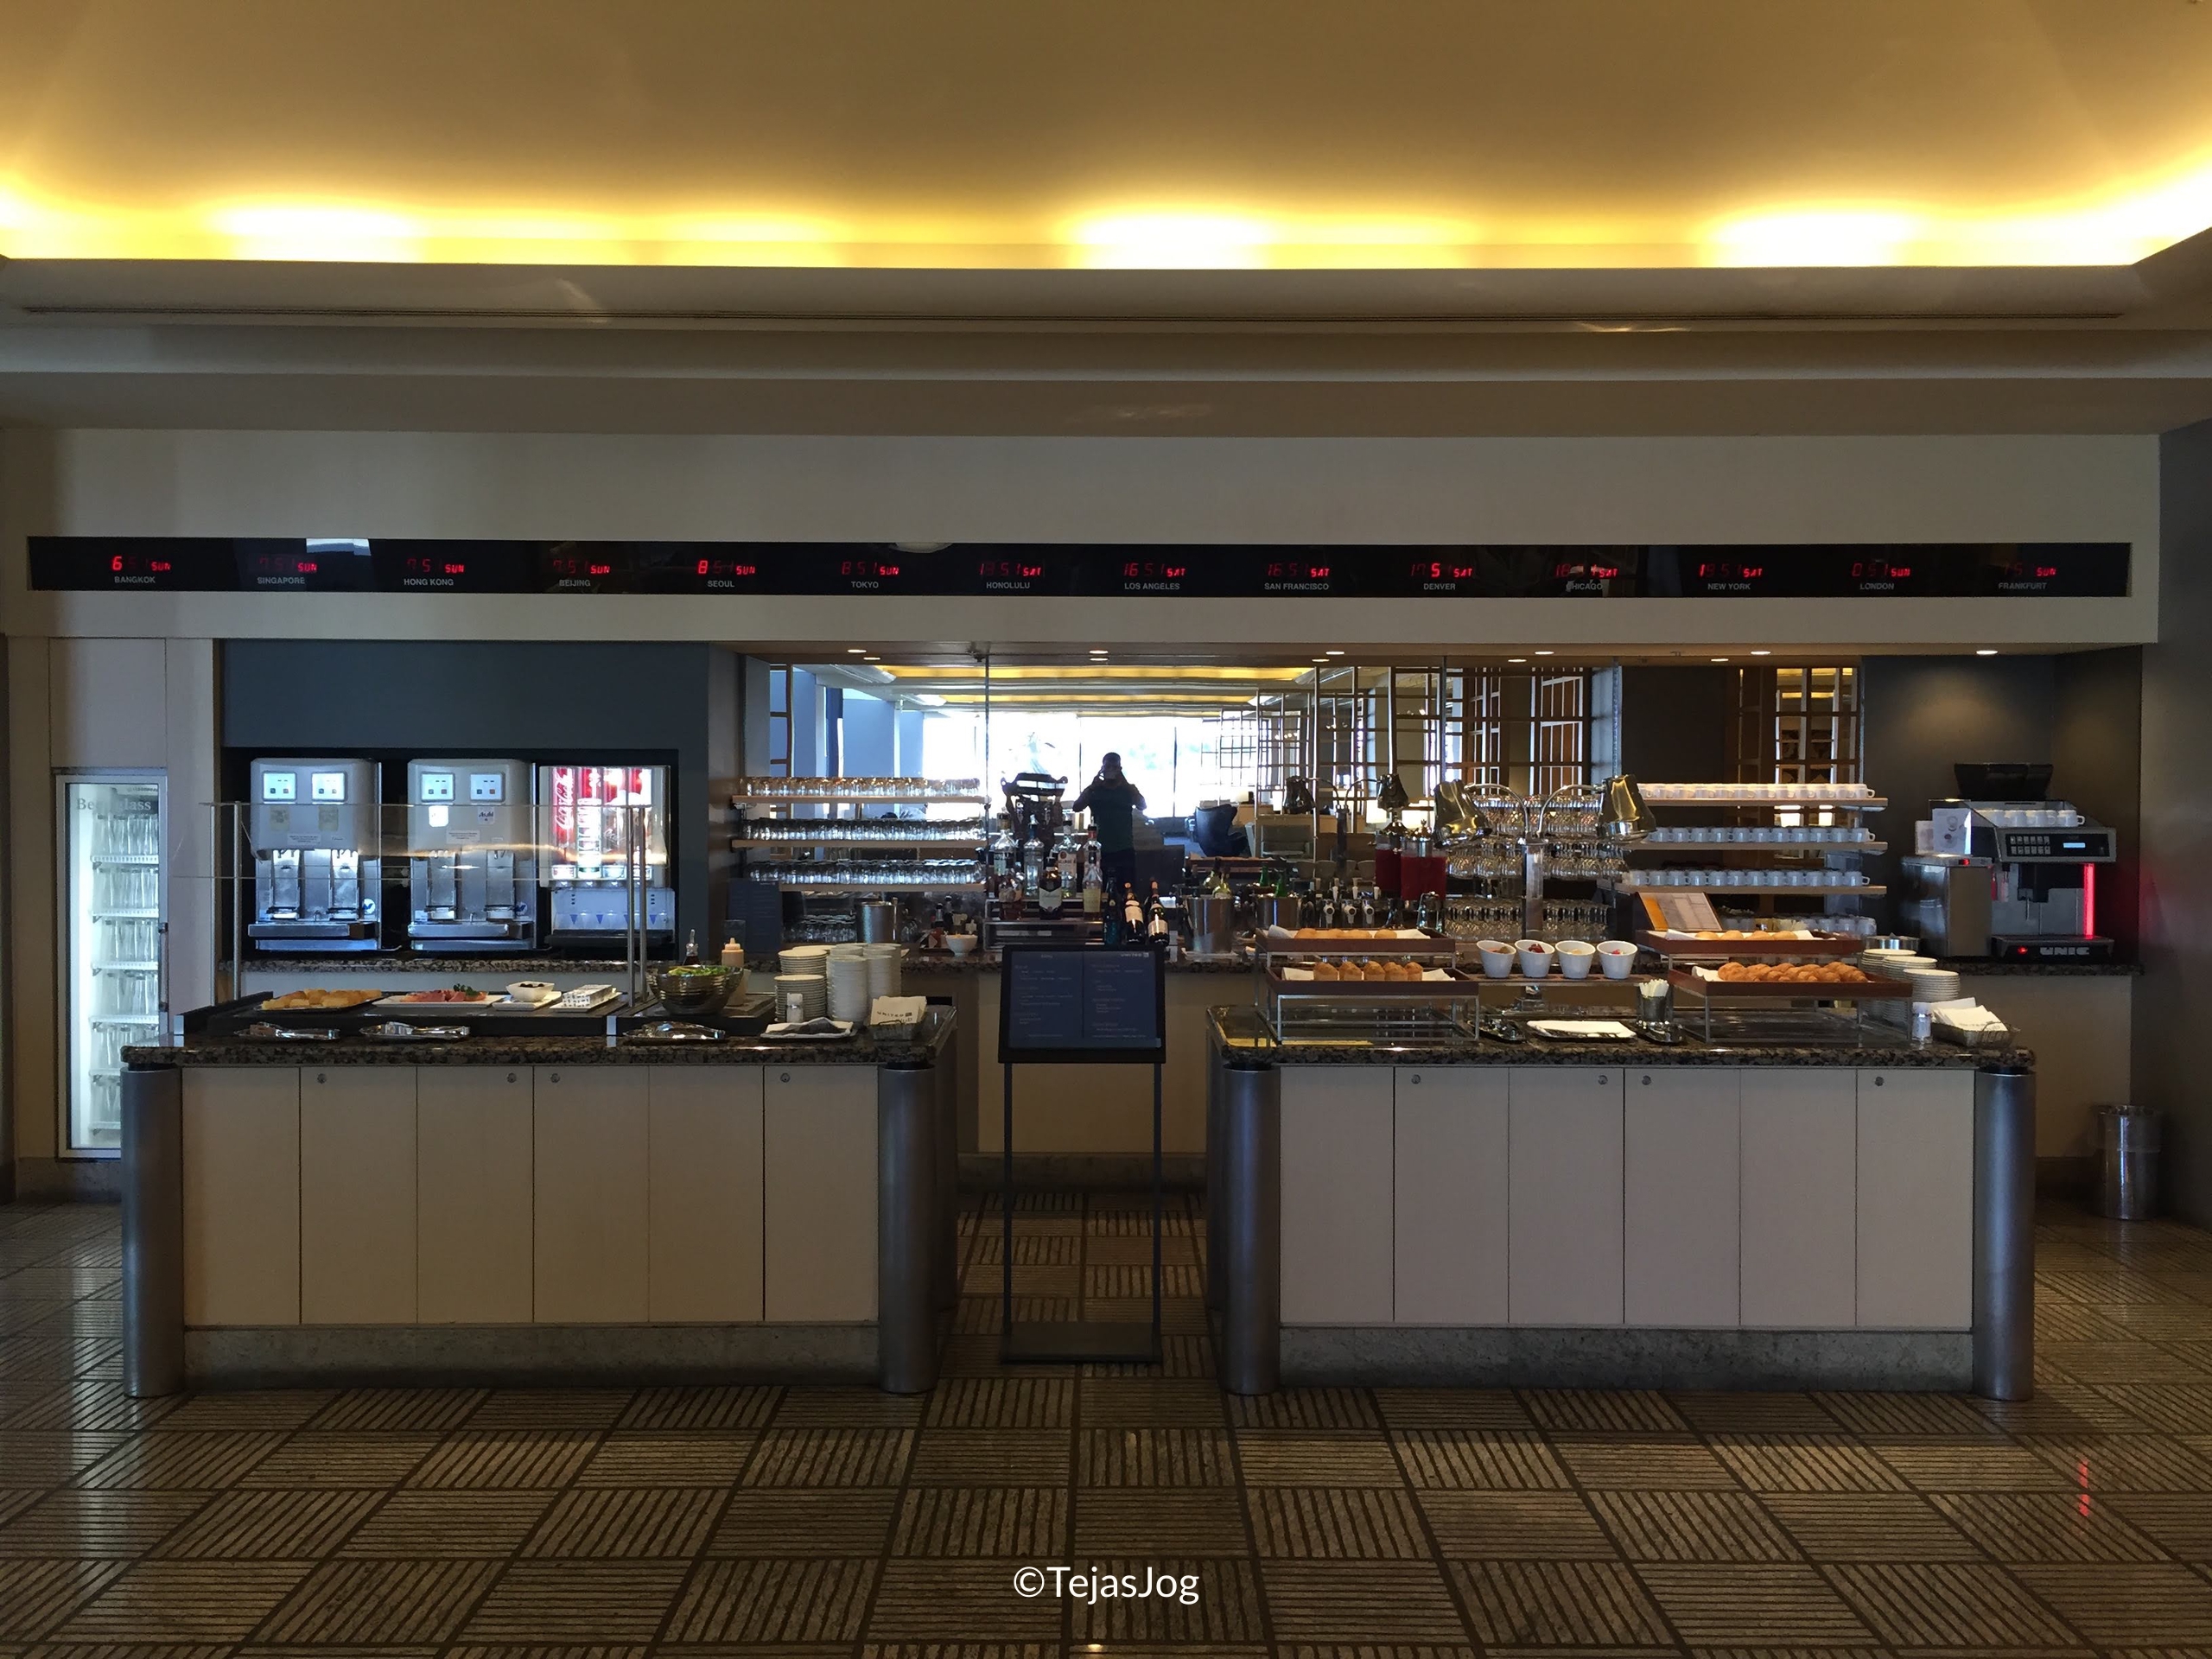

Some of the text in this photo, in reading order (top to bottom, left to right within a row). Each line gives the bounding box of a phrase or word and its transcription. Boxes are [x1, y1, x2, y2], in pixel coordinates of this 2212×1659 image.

[150, 561, 171, 573] SUN
[297, 563, 318, 573] SUN
[444, 563, 465, 575] SUN
[590, 564, 611, 575] SUN
[735, 564, 757, 575] SUN
[879, 565, 899, 576] SUN
[1022, 566, 1042, 577] SAT
[1166, 566, 1187, 578] SAT
[1599, 567, 1618, 578] SAT
[1743, 567, 1764, 578] SAT
[1890, 567, 1911, 578] SUN
[2035, 566, 2057, 578] SUN
[1310, 567, 1331, 579] SAT
[1452, 567, 1473, 579] SAT
[1264, 582, 1330, 591] SAN FRANCISCO
[1566, 582, 1603, 591] CHICAGO
[2039, 946, 2090, 956] UNIC
